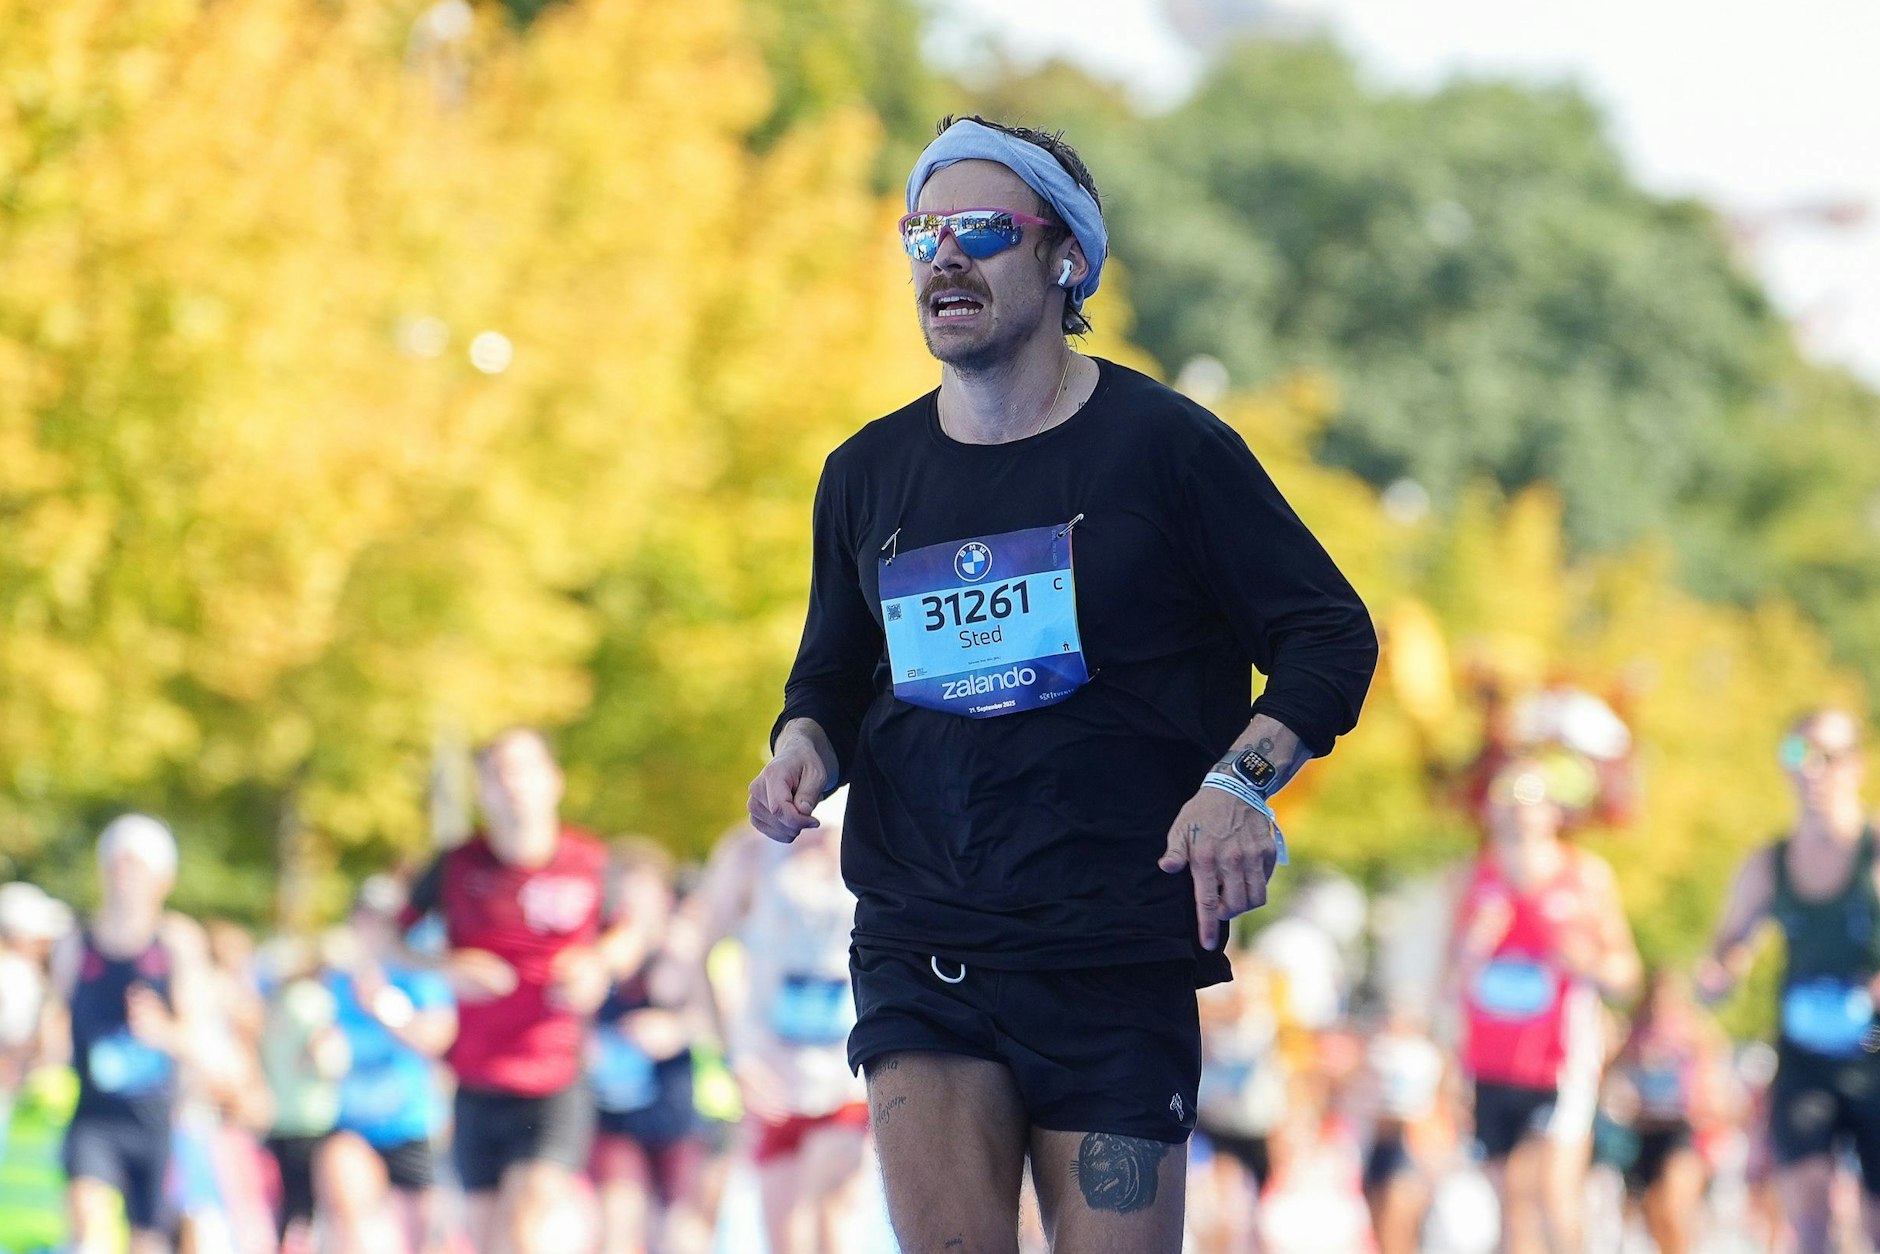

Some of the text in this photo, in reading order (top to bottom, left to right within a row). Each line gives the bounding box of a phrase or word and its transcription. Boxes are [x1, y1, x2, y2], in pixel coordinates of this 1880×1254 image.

[960, 545, 986, 558] BMW
[1053, 577, 1063, 591] C
[922, 580, 1029, 631] 31261
[959, 625, 1002, 648] Sted
[942, 666, 1036, 700] zalando
[976, 703, 1003, 712] September
[1003, 700, 1017, 708] 2025
